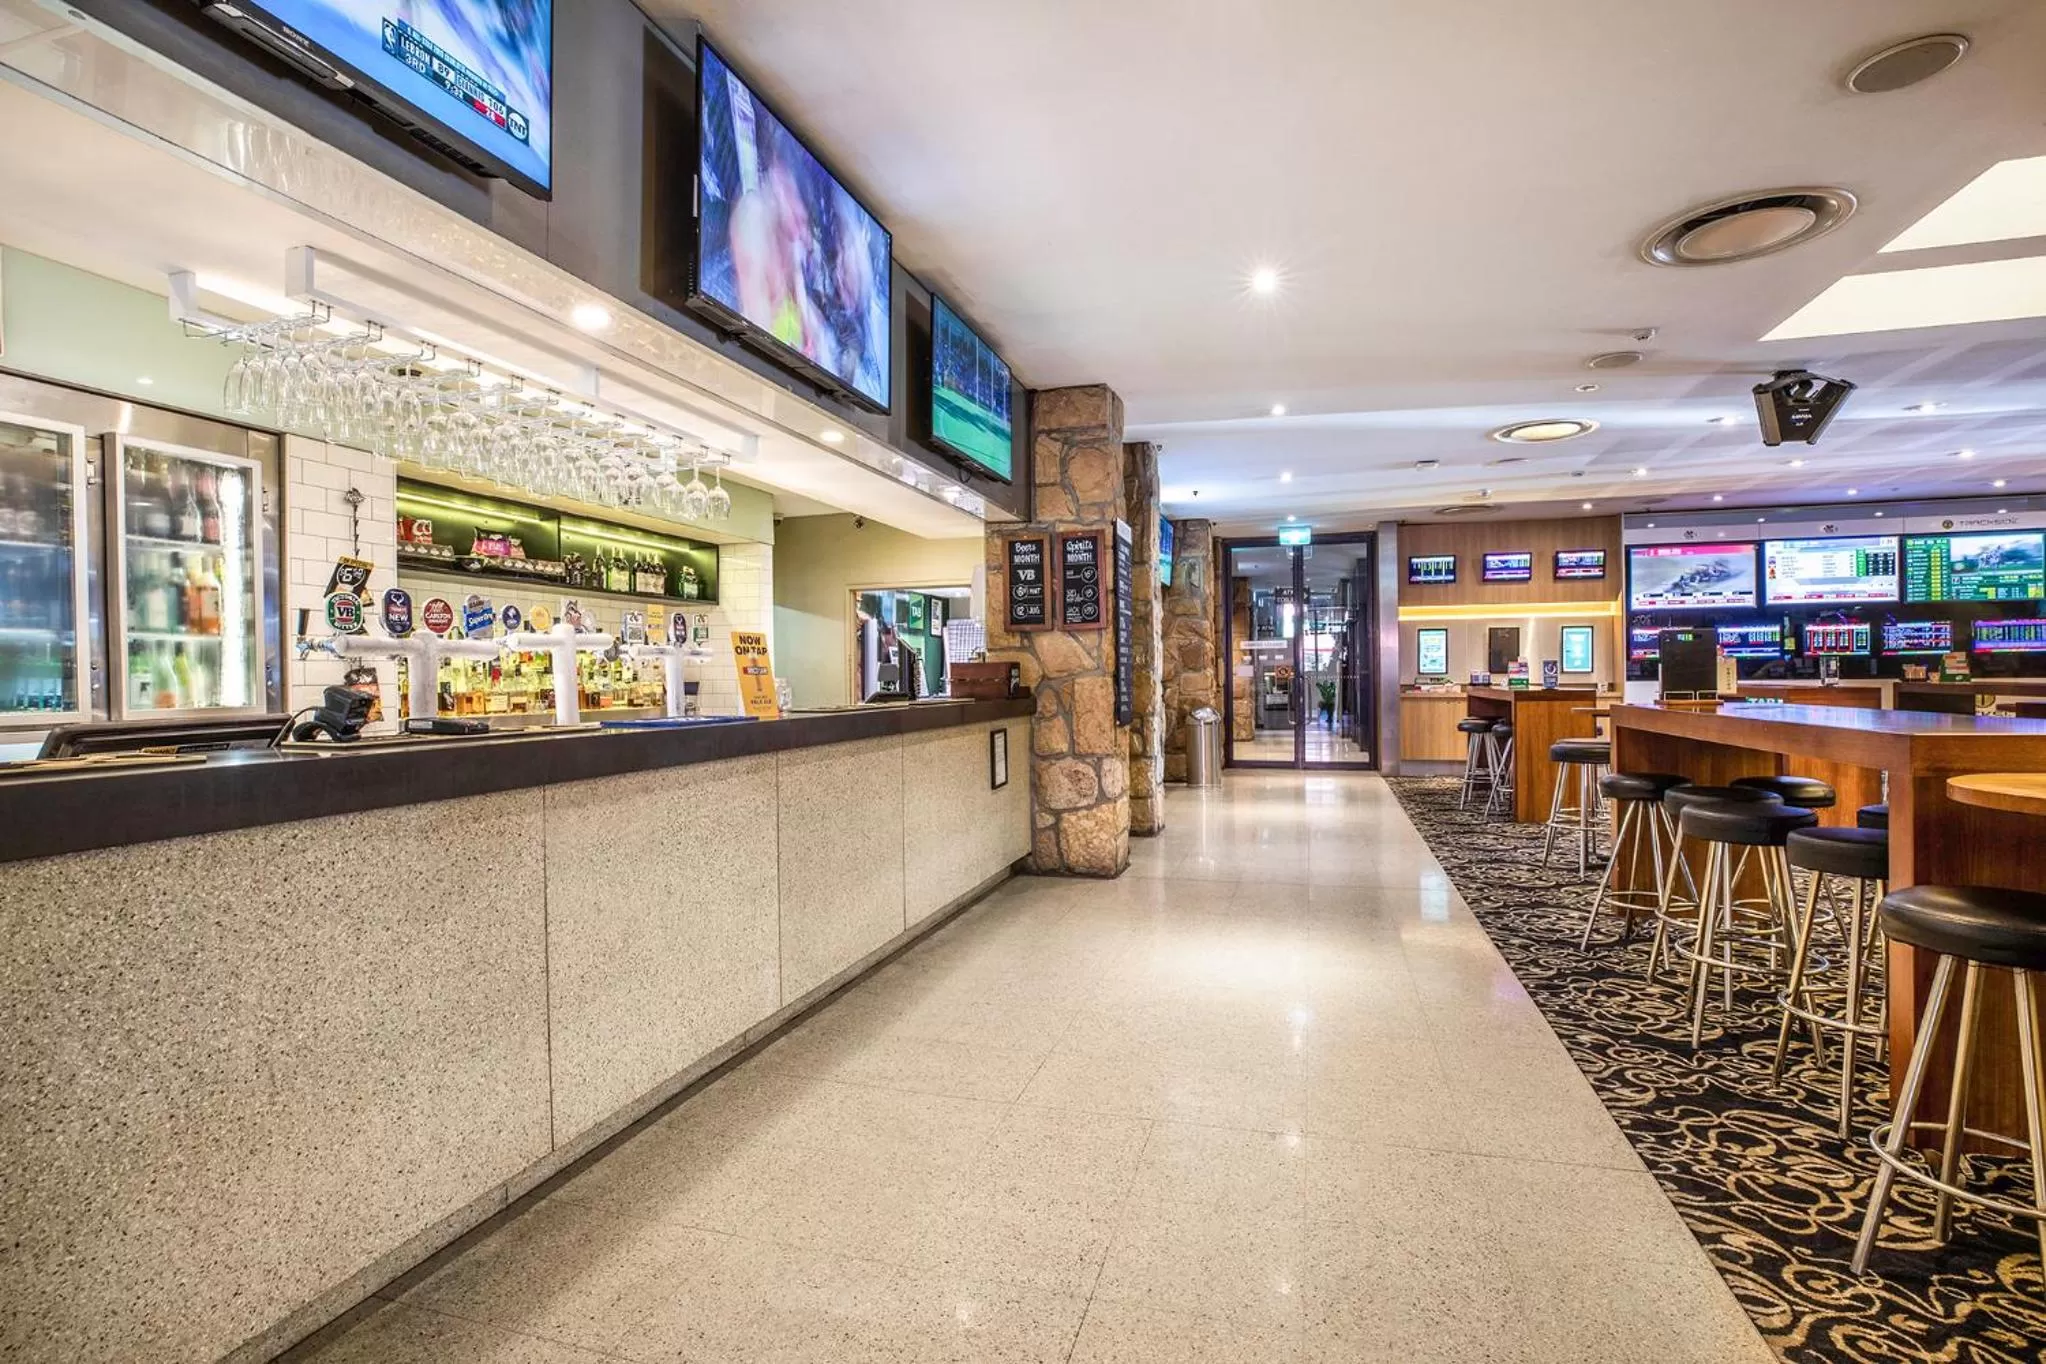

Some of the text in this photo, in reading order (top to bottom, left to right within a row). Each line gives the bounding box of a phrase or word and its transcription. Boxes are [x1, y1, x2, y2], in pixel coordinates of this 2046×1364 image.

[400, 37, 431, 64] LEBRON
[437, 62, 450, 78] 89
[404, 53, 425, 73] 3RD
[509, 118, 527, 136] TNT
[1066, 540, 1093, 552] Spirits
[1014, 554, 1040, 564] MONTH
[1067, 552, 1092, 562] MONTH
[1017, 569, 1036, 581] VB
[336, 606, 354, 617] VB
[911, 606, 922, 619] TAB
[388, 613, 409, 622] NEW
[739, 635, 760, 645] NOW
[735, 646, 768, 655] ON TAP
